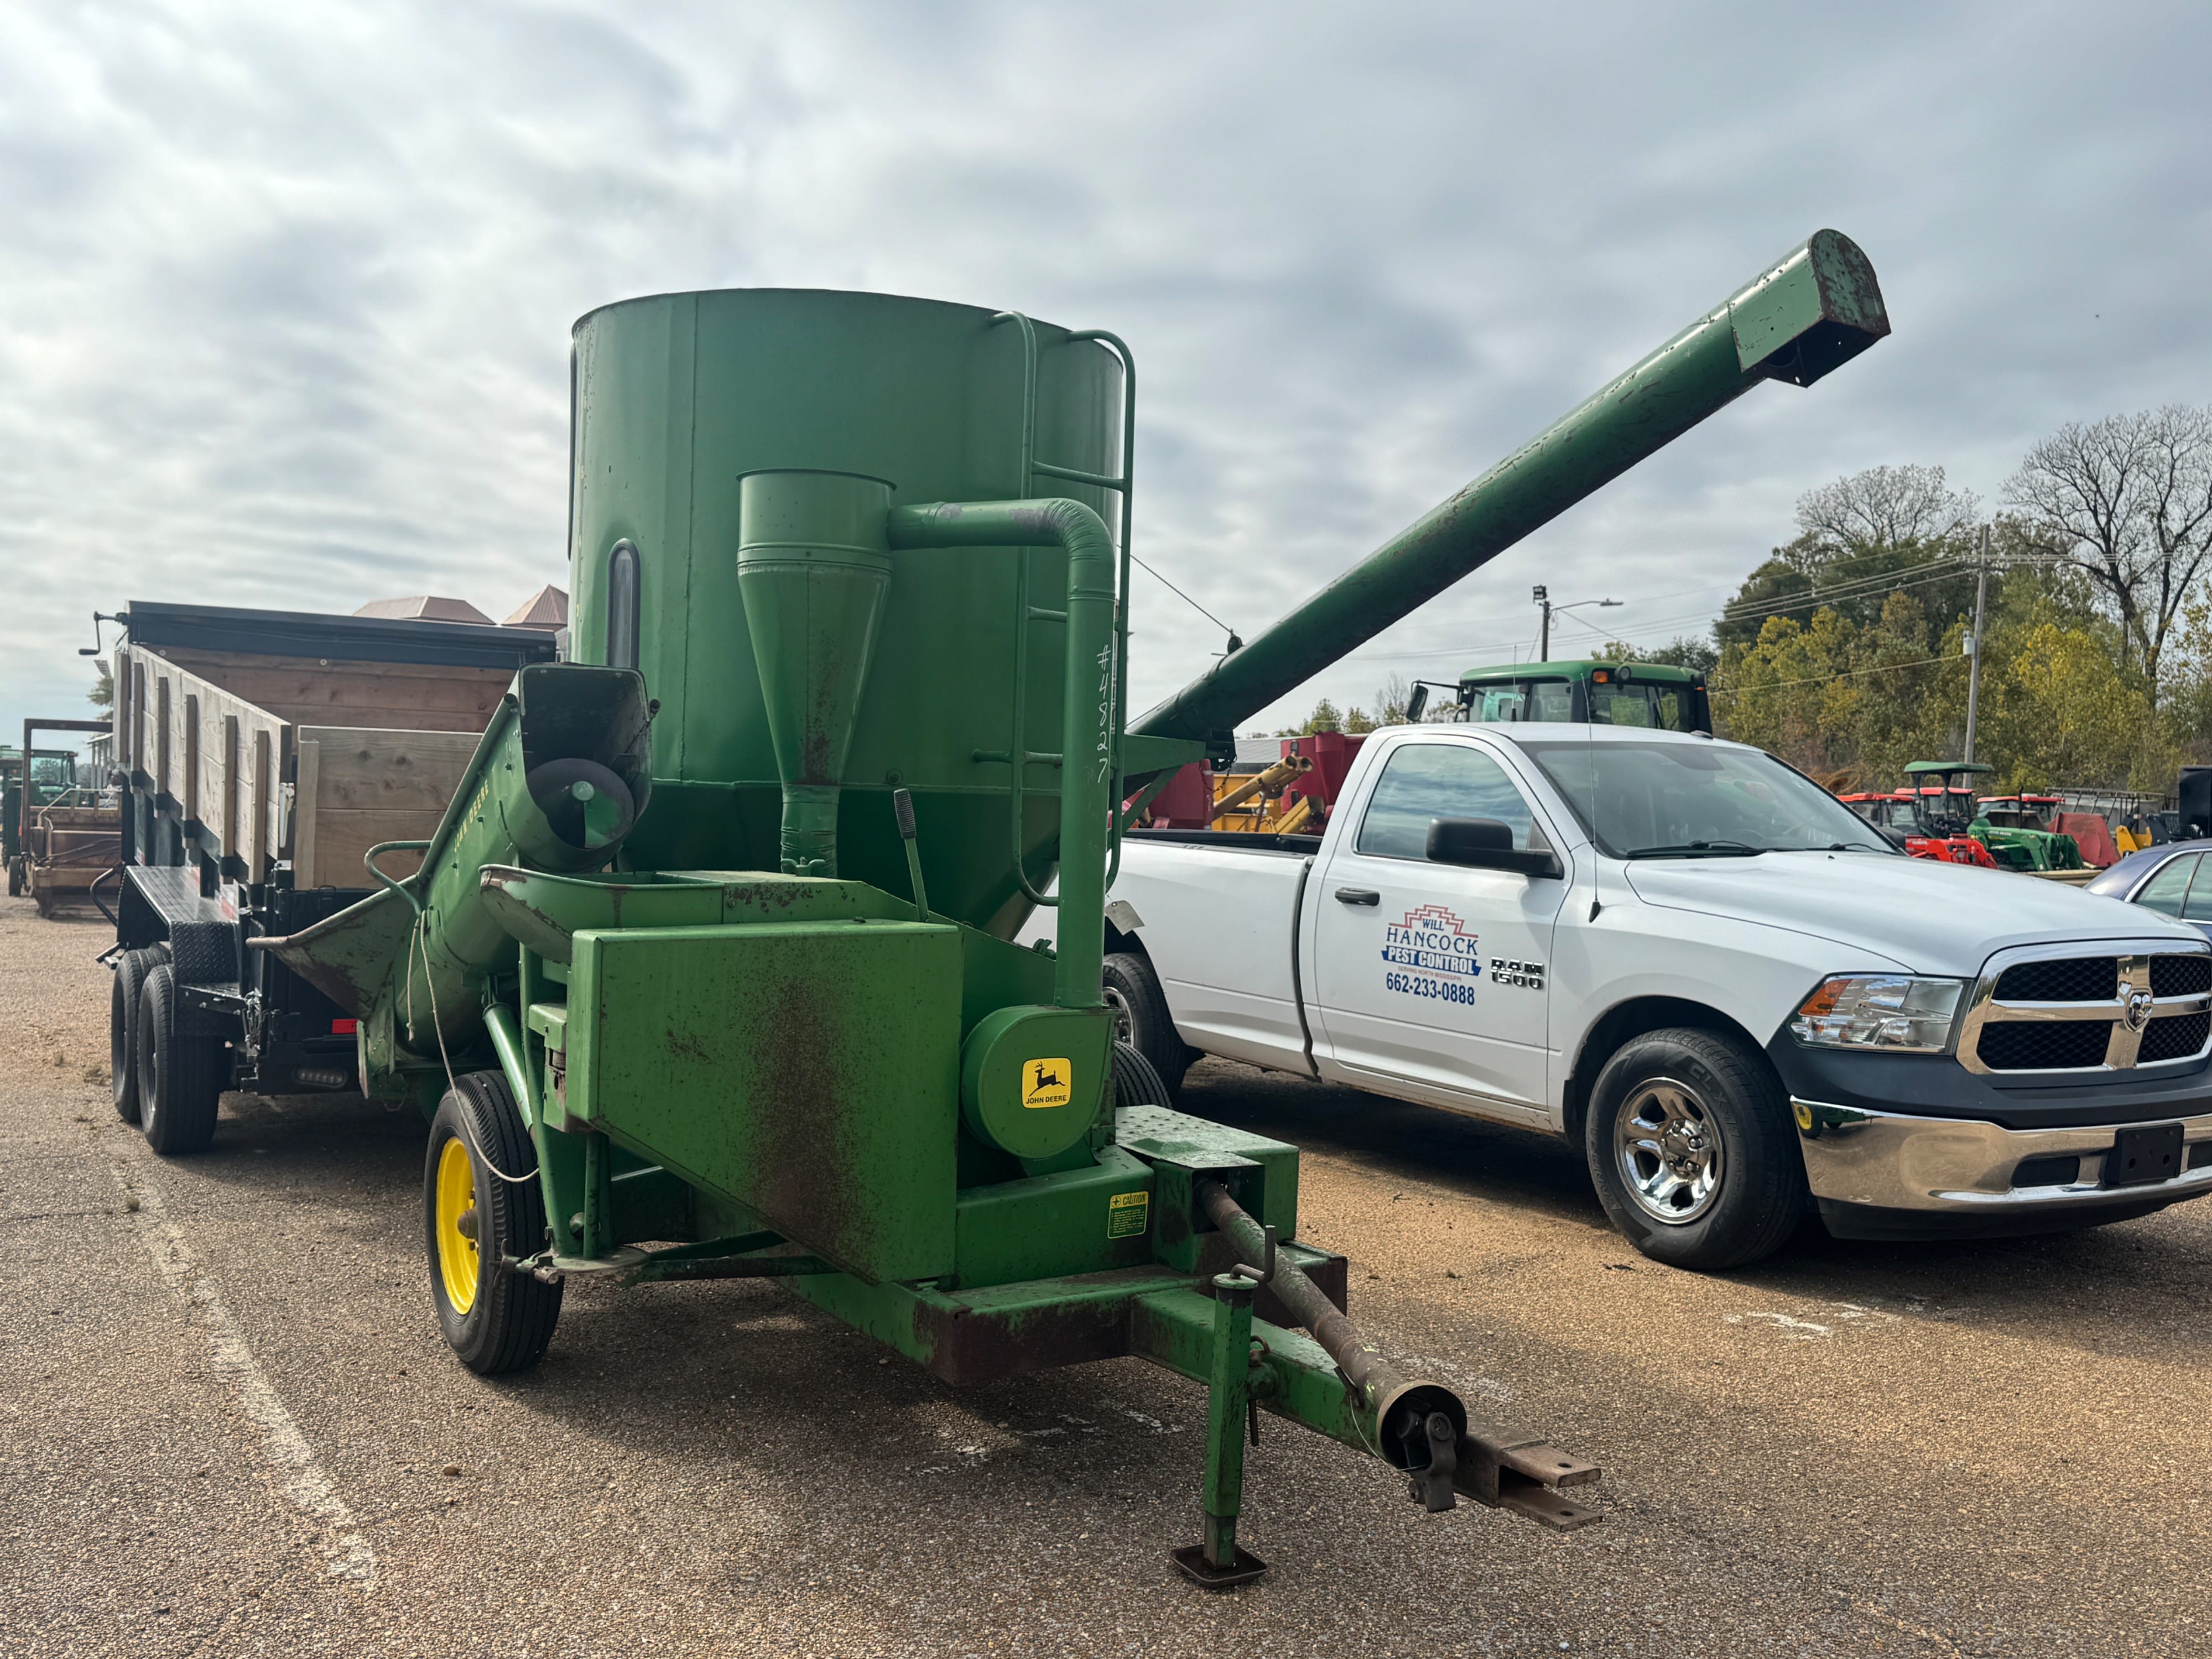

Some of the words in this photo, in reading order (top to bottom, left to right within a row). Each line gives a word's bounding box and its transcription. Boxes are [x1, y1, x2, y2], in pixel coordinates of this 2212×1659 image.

[454, 818, 467, 853] JOHN
[469, 779, 489, 823] DEERE
[1423, 918, 1444, 931] WILL
[1386, 927, 1479, 956] HANCOCK
[1388, 947, 1417, 964] PEST
[1418, 951, 1474, 974] CONTROL
[1491, 956, 1544, 976] RAM
[1398, 966, 1417, 974] SERVING
[1435, 972, 1462, 982] MISSISSIPPI
[1490, 969, 1544, 990] 1500
[1386, 972, 1475, 1005] 662-233-0888
[1123, 1194, 1146, 1205] CAUTION
